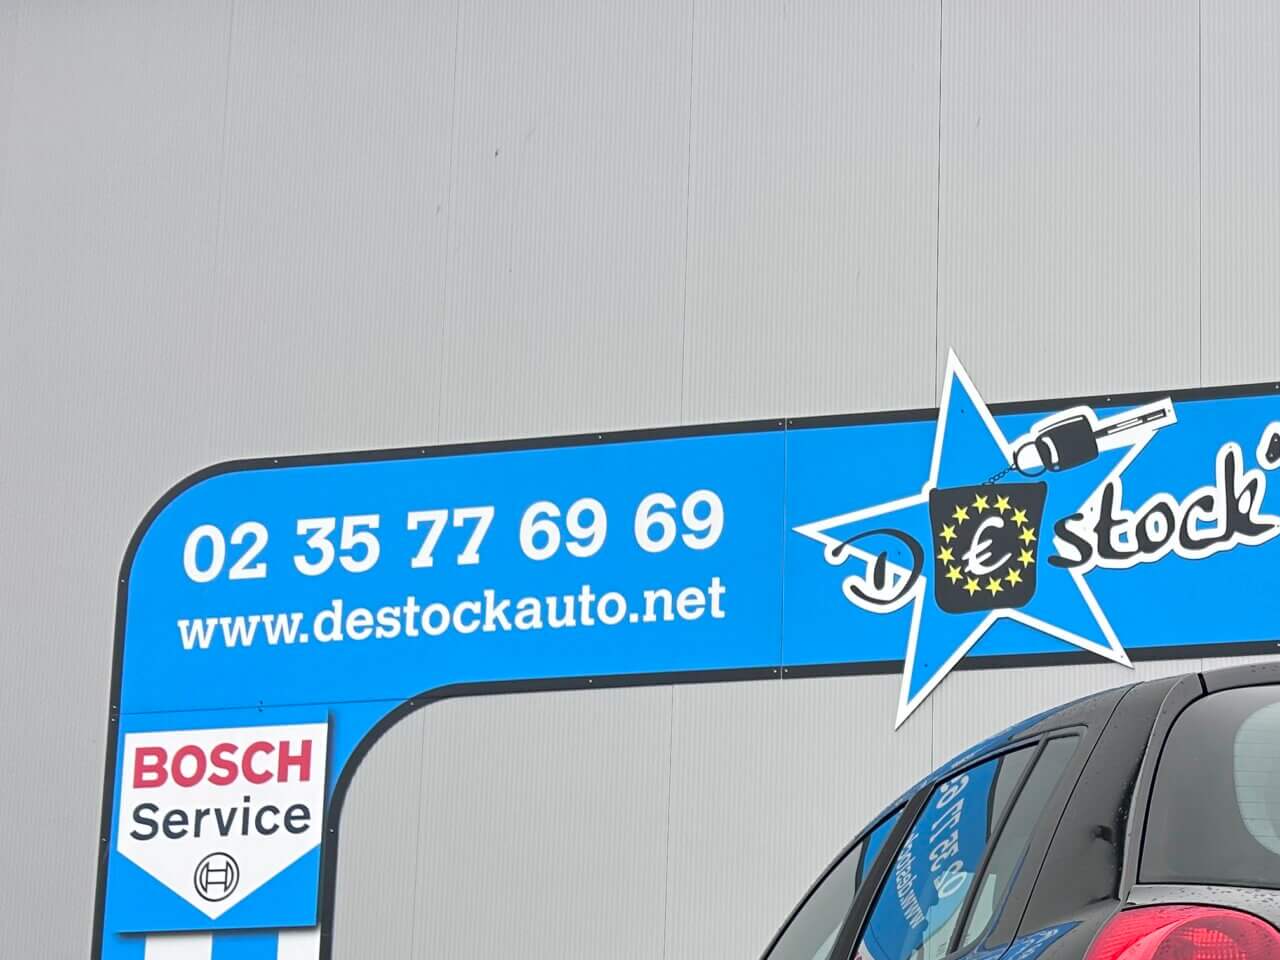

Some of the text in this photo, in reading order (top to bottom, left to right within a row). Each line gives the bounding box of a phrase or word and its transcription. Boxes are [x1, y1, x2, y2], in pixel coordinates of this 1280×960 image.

[183, 490, 724, 582] 02 35 77 69 69
[177, 576, 726, 650] www.destockauto.net
[132, 739, 313, 789] BOSCH
[130, 795, 311, 841] Service
